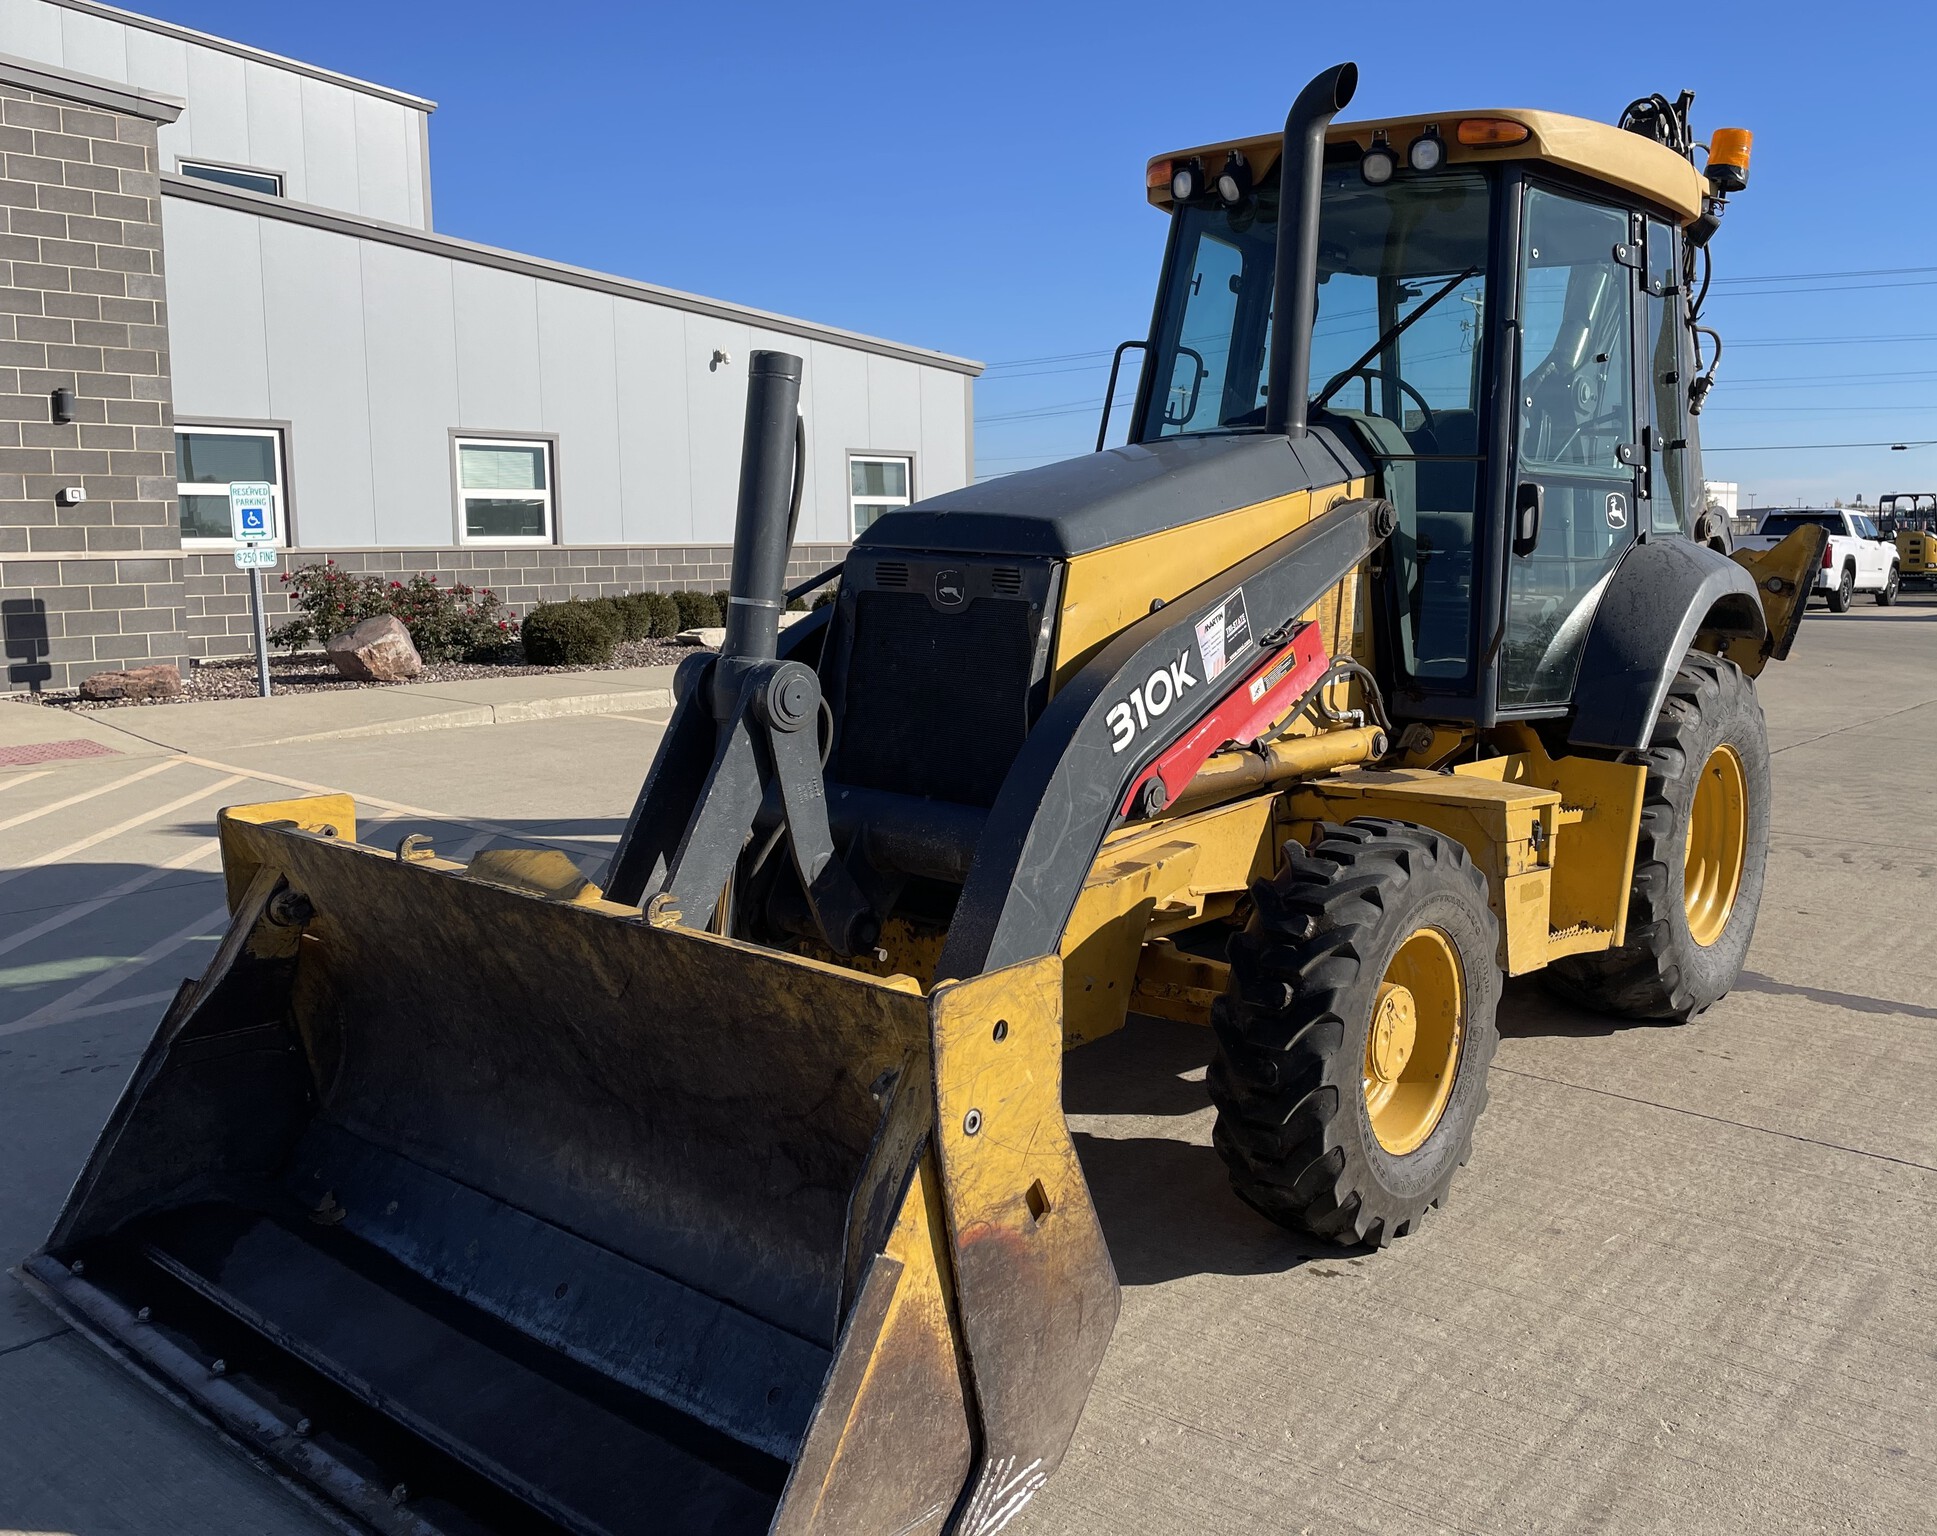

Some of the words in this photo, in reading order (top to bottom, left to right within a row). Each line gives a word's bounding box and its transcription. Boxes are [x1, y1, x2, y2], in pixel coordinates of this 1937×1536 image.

[233, 488, 268, 496] RESERVED
[236, 498, 267, 506] PARKING
[260, 551, 274, 562] FINE
[1204, 612, 1223, 633] MARTIN
[1105, 648, 1199, 755] 310K
